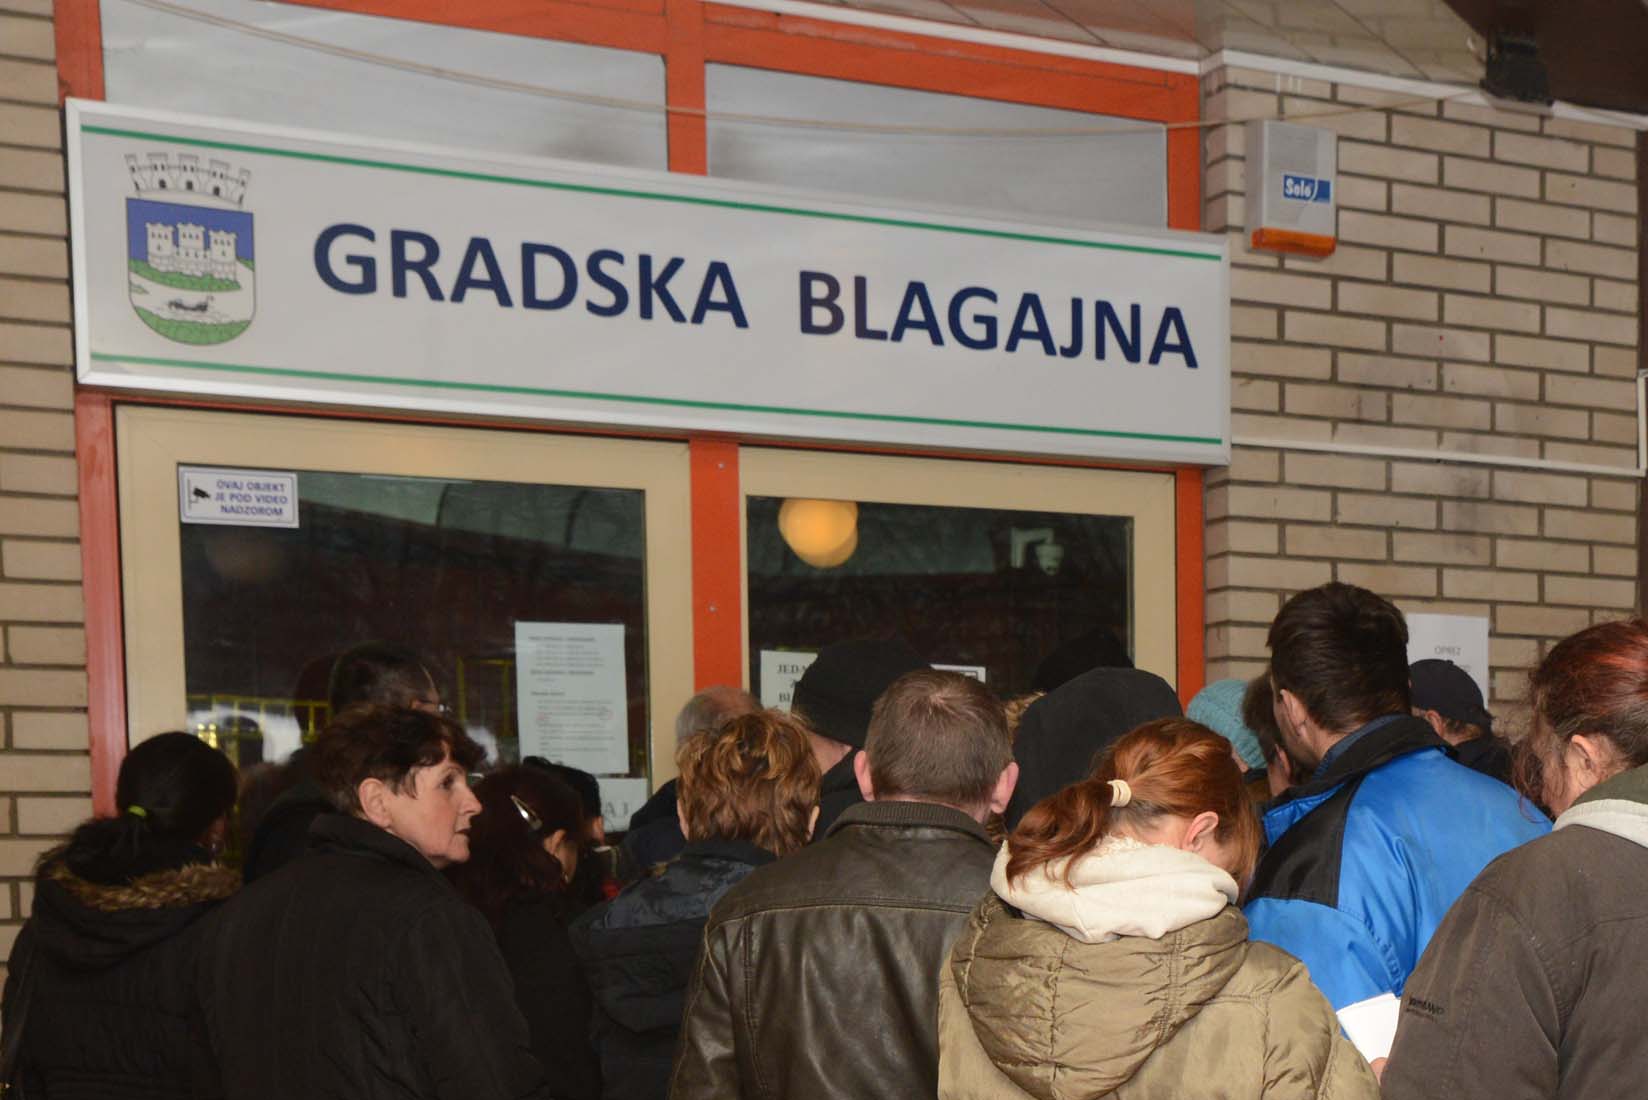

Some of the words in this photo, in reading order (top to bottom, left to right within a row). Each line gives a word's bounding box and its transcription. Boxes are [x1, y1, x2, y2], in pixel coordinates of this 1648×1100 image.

[313, 223, 750, 329] GRADSKA
[799, 270, 1199, 369] BLAGAJNA
[216, 480, 243, 490] OVAJ
[246, 482, 284, 492] OBJEKT
[216, 493, 225, 502] JE
[230, 493, 252, 503] POD
[255, 495, 288, 504] VIDEO
[221, 505, 283, 515] NADZOROM
